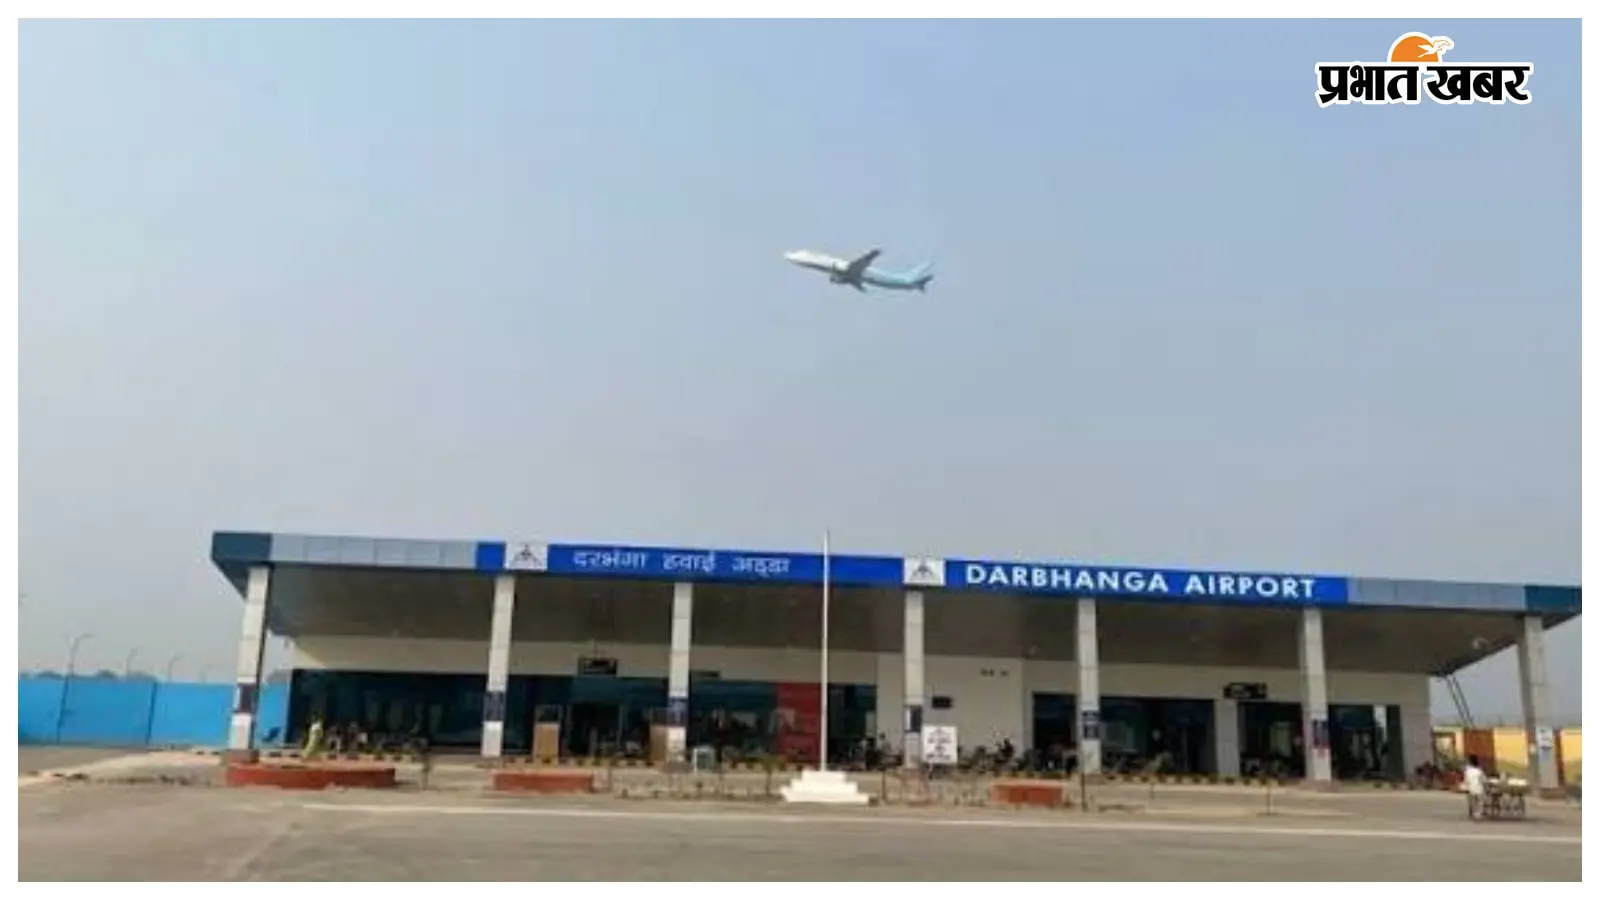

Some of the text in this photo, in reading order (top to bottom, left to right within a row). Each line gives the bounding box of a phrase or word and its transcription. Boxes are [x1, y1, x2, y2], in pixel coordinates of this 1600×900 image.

[572, 550, 646, 569] दरभंगा
[663, 550, 716, 572] हवाई
[966, 564, 1316, 598] DARBHANGA AIRPORT
